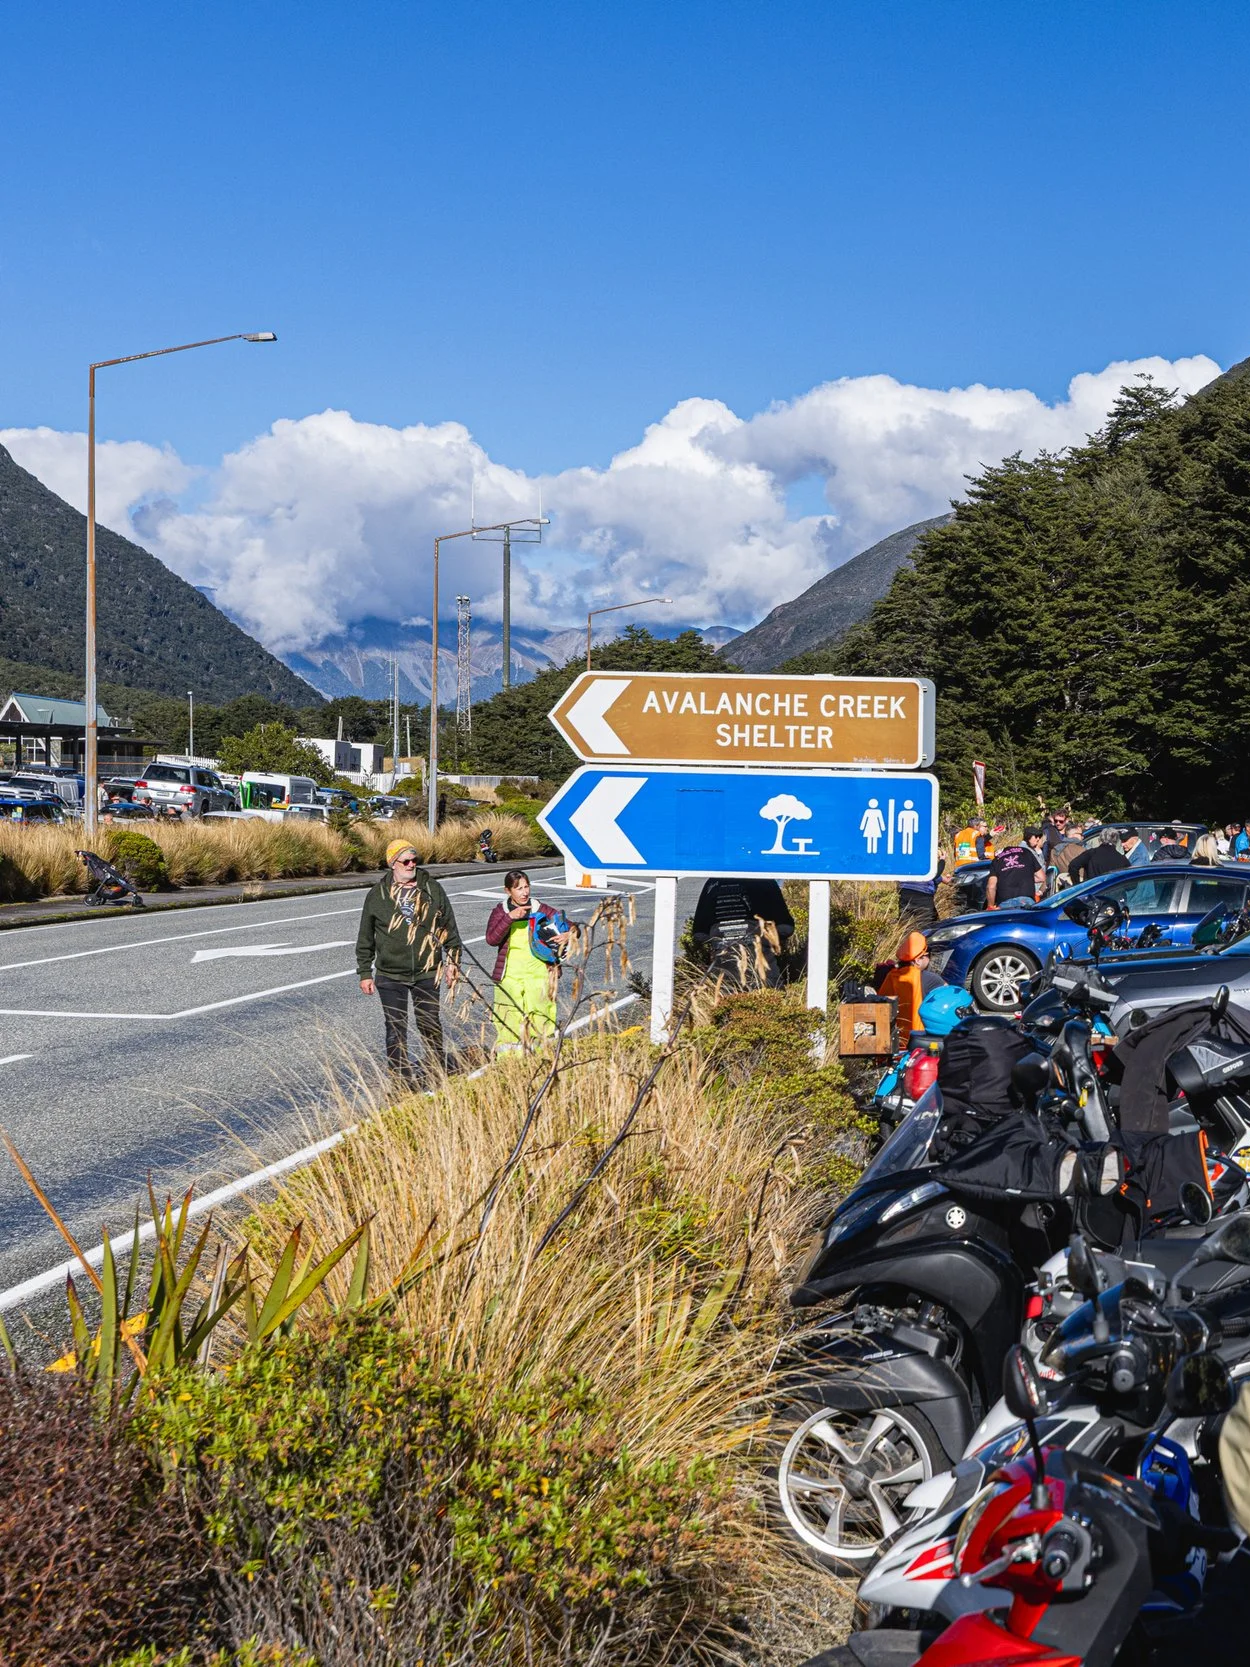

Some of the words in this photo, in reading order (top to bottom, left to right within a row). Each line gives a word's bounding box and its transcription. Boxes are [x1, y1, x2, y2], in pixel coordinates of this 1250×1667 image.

[642, 690, 808, 717] AVALANCHE
[819, 694, 906, 719] CREEK
[715, 723, 833, 749] SHELTER
